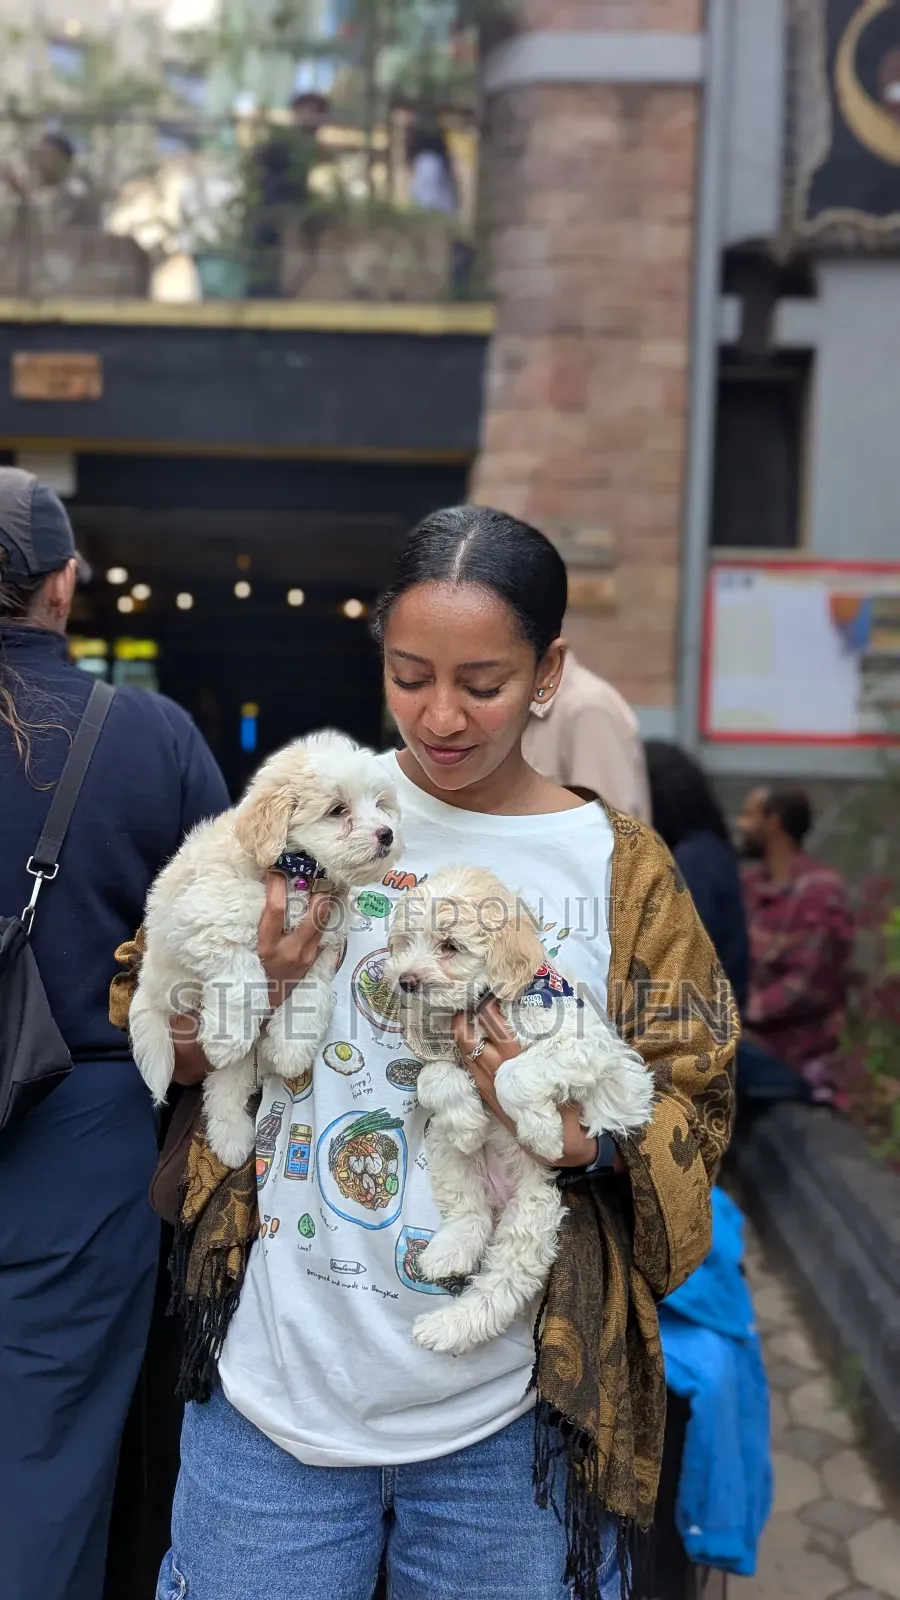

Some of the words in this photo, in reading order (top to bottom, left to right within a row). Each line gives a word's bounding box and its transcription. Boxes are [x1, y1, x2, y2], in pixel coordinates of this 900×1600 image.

[306, 1268, 331, 1282] Designed
[341, 1281, 359, 1290] made
[361, 1283, 369, 1291] in
